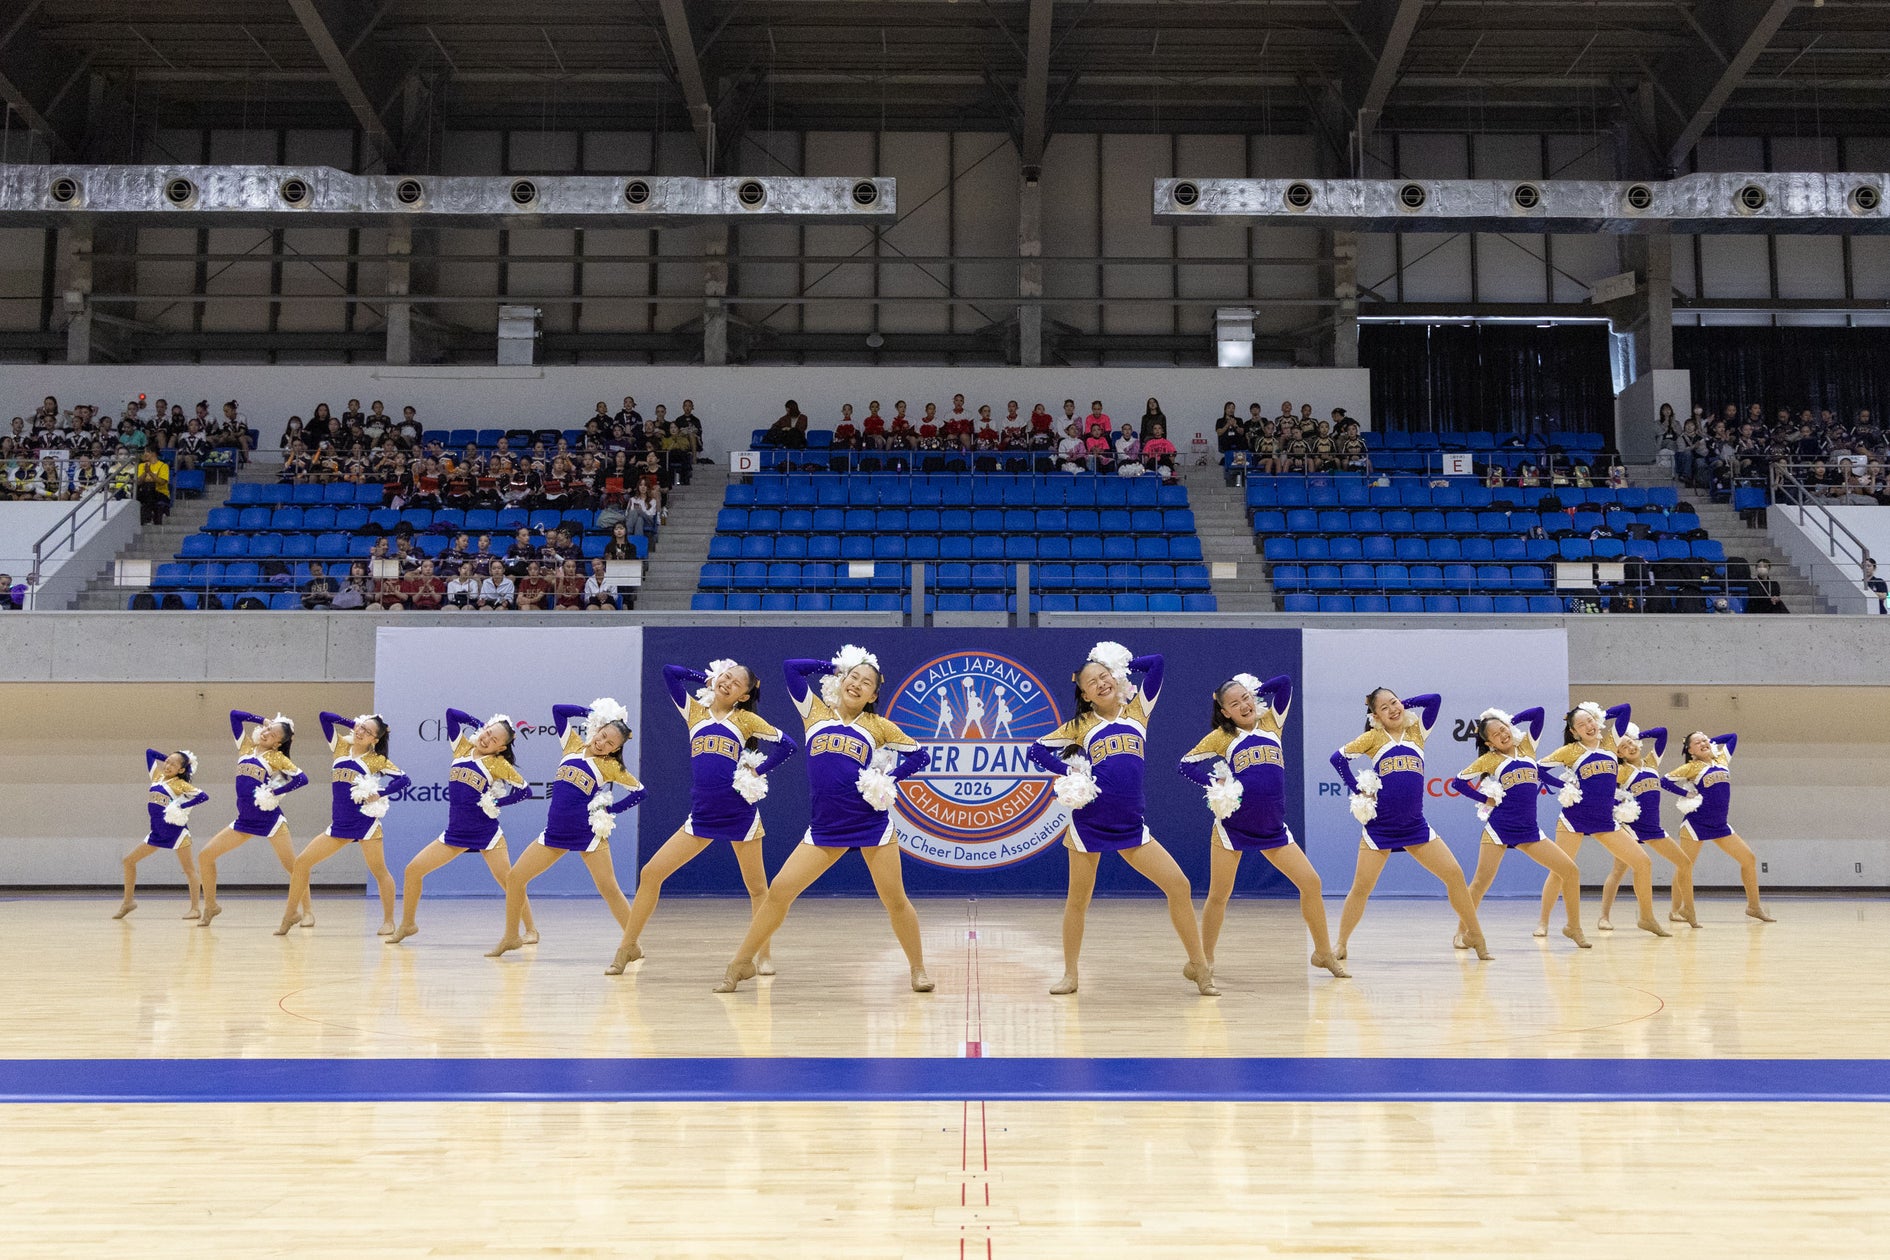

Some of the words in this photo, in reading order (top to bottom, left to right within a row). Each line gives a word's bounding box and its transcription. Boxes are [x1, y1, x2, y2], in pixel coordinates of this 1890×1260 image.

[740, 457, 751, 470] D
[1453, 459, 1463, 472] E
[929, 661, 957, 683] ALL
[963, 657, 1021, 685] JAPAN
[691, 735, 740, 763] SOEI
[810, 733, 870, 767] SOEI
[1089, 733, 1145, 766] SOEI
[554, 765, 596, 796] SOEI
[954, 781, 992, 797] 2026
[909, 783, 1033, 827] CHAMPIONSHIP
[911, 835, 951, 859] Cheer
[954, 847, 998, 861] Dance
[1001, 812, 1067, 858] Association
